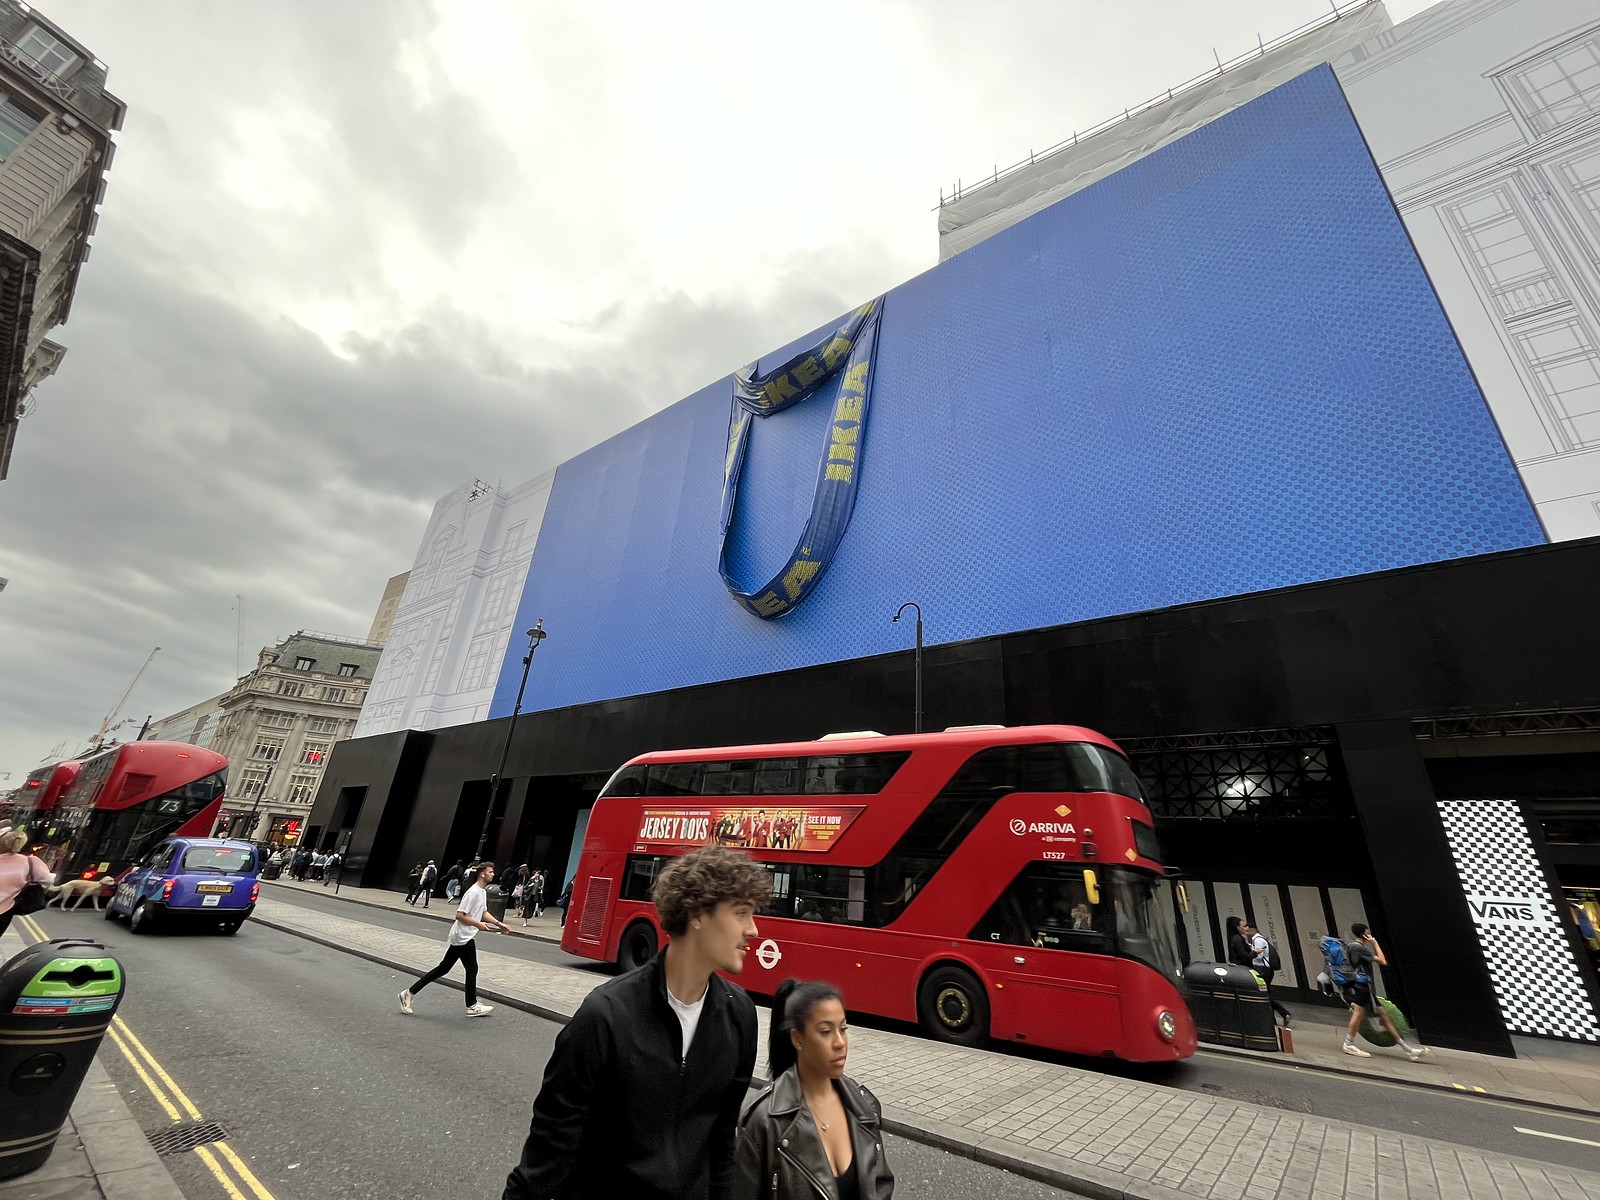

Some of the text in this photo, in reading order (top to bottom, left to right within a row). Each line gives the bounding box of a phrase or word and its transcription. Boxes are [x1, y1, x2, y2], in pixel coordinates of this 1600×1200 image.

[824, 360, 868, 485] IKEA
[160, 799, 180, 812] 73
[807, 816, 841, 825] SEE IT NOW
[640, 816, 709, 841] JERSEY BOYS
[1028, 822, 1076, 834] ARRIVA
[1042, 851, 1066, 860] LT527
[1467, 900, 1535, 921] VANS
[990, 932, 1001, 940] CT
